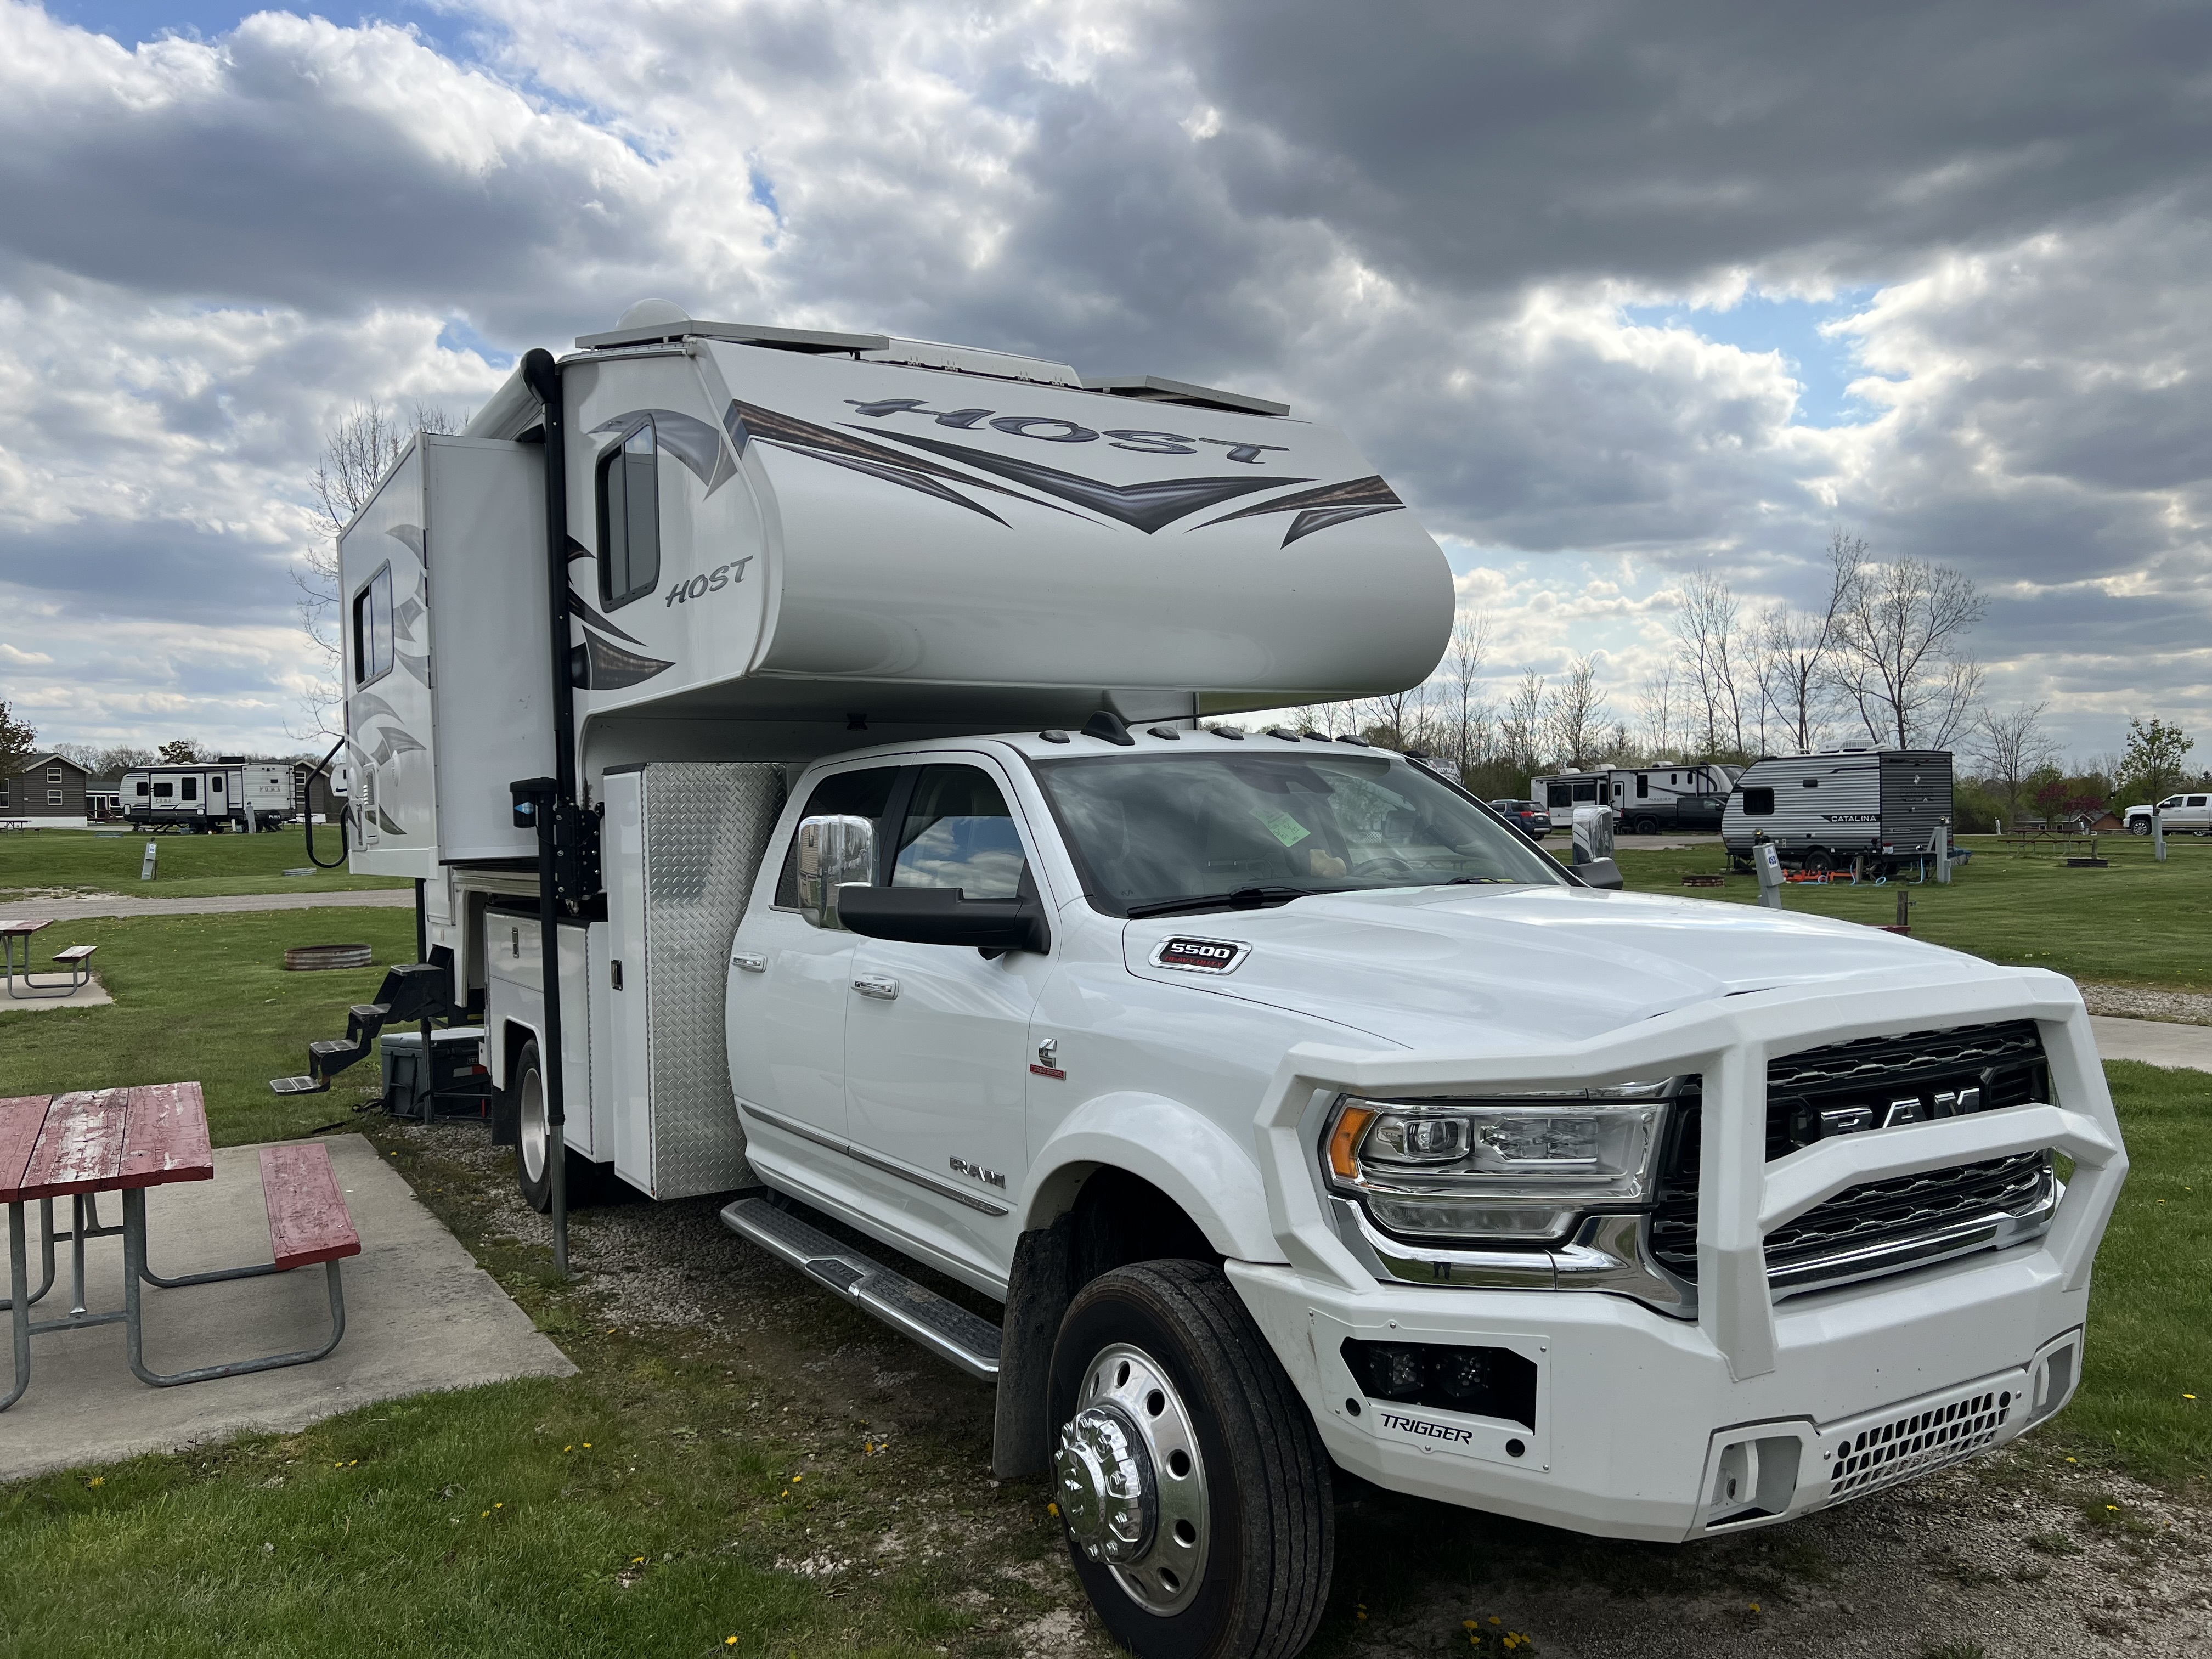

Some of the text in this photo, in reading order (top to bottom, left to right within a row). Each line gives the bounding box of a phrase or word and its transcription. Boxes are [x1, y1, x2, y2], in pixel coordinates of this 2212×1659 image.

[843, 398, 1290, 464] HOST
[665, 555, 753, 607] HOST
[1768, 855, 1776, 865] 453
[1164, 956, 1225, 967] HEAVY DUTY
[1170, 943, 1231, 959] 5500
[1031, 1065, 1063, 1077] TURBO DIESEL
[1820, 1087, 1980, 1138] RAM
[949, 1155, 1006, 1189] RAM
[952, 1191, 993, 1213] LIMITED
[821, 1260, 859, 1279] RAM
[1380, 1413, 1472, 1445] TRIGGER
